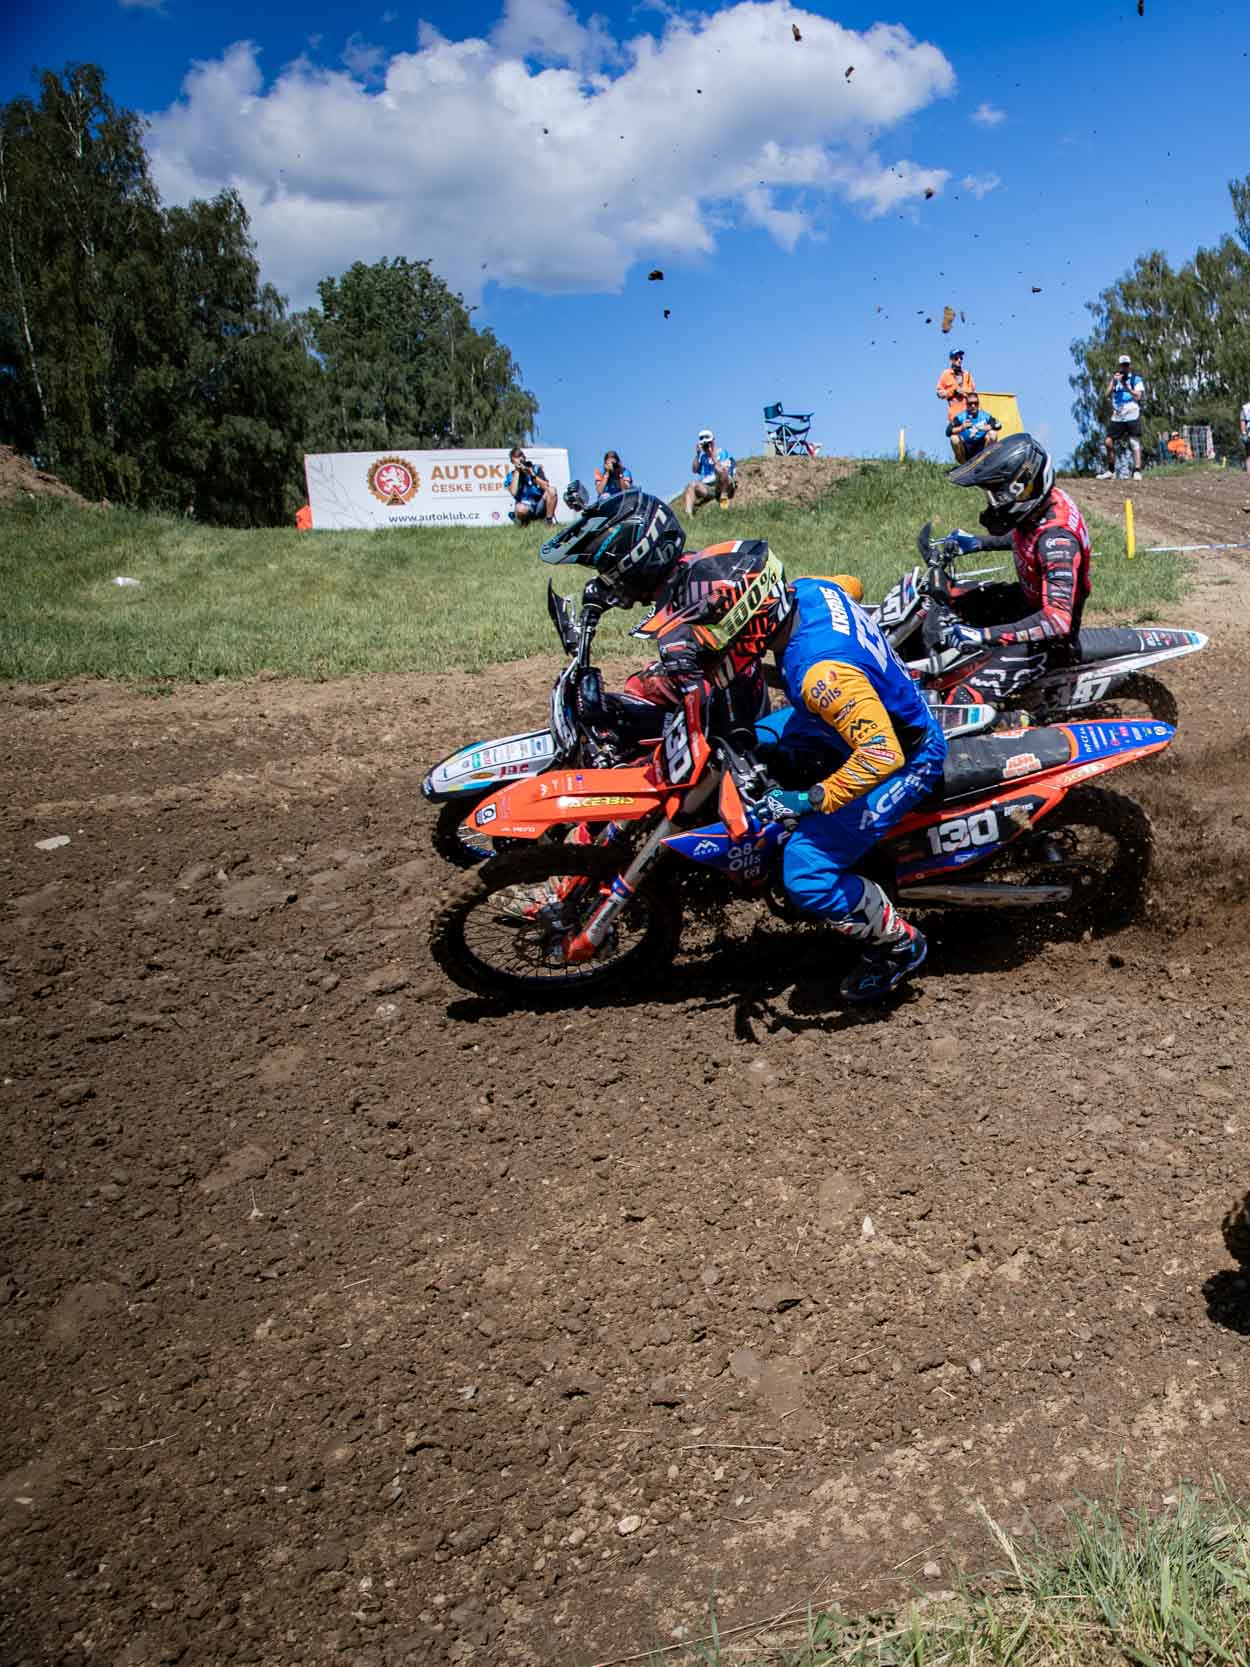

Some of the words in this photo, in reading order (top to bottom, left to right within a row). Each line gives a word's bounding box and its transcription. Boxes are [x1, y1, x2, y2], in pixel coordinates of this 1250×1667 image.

[388, 511, 481, 523] www.autoklub.cz
[722, 568, 778, 637] 100%
[811, 680, 827, 699] Q8
[927, 809, 998, 855] 130
[728, 842, 752, 858] Q8
